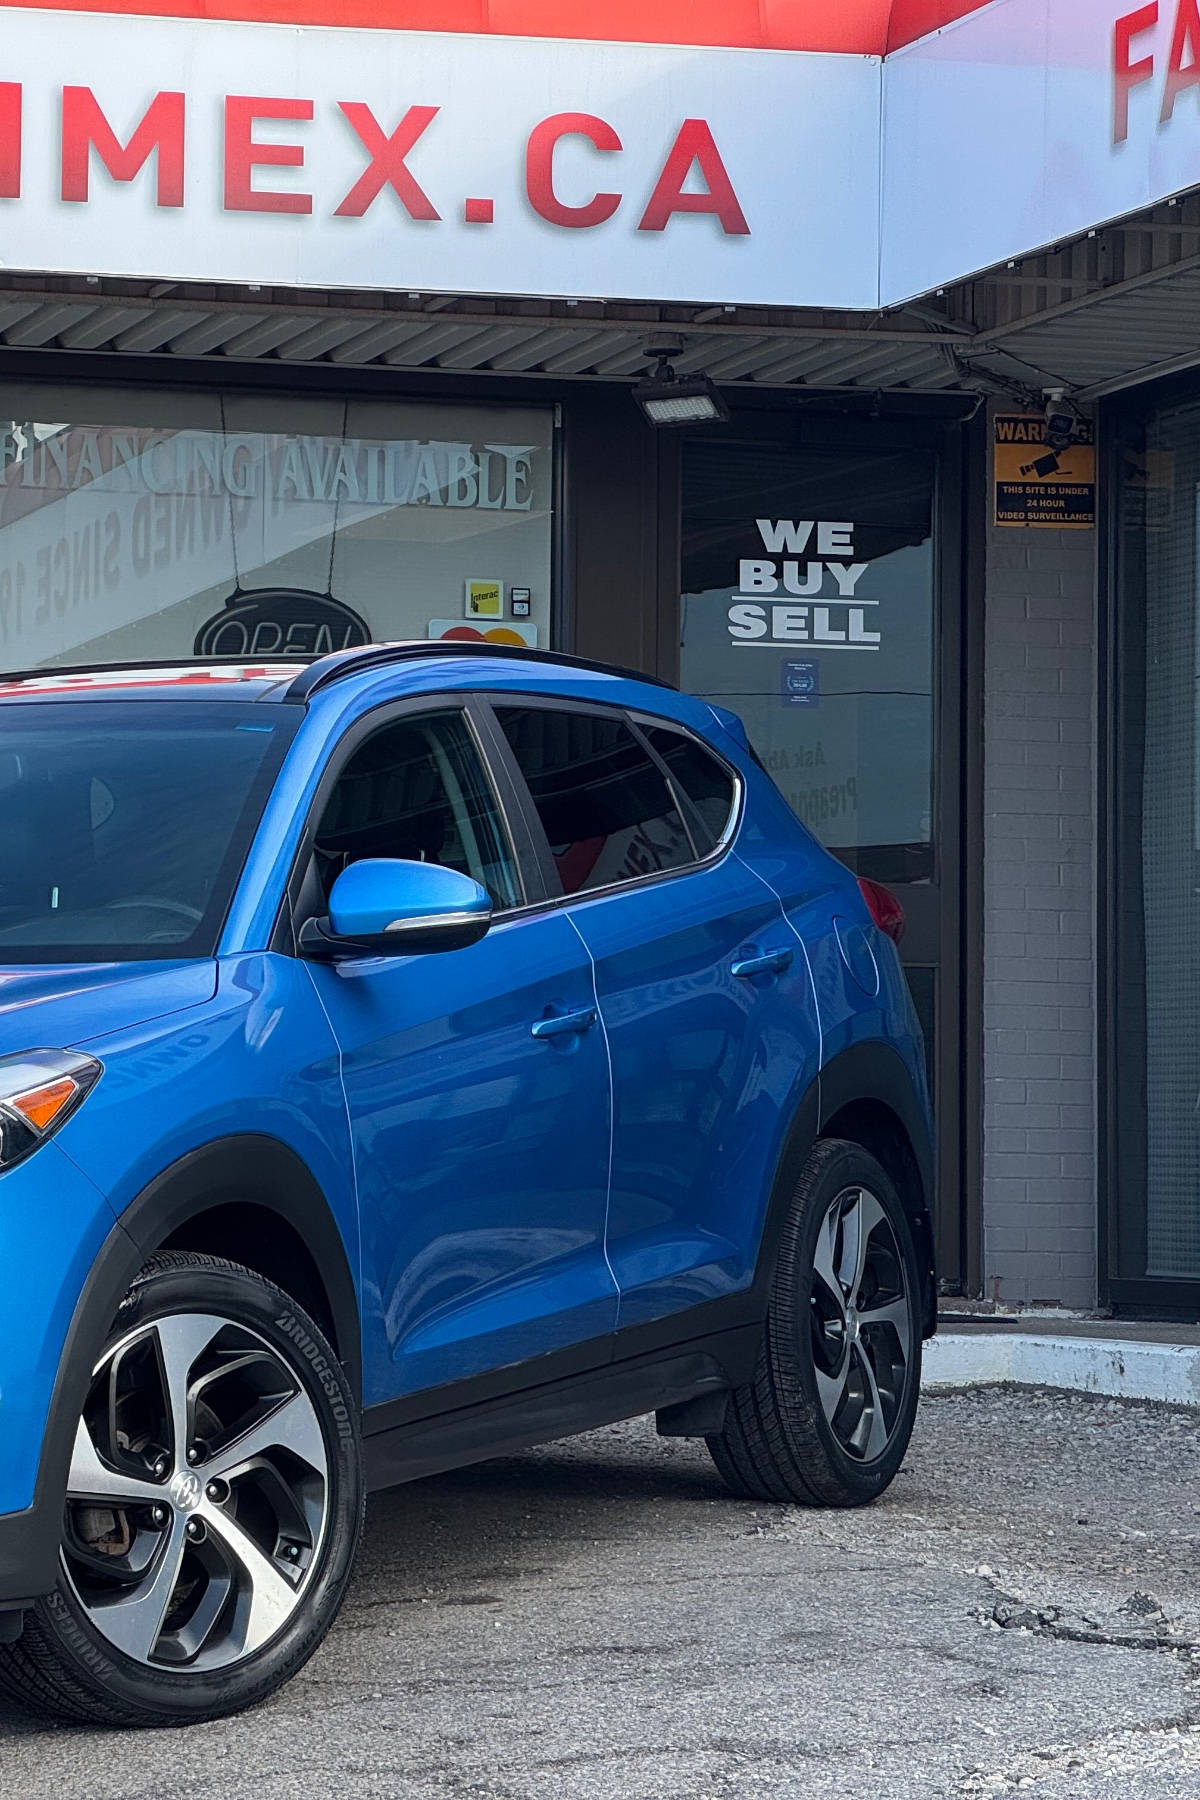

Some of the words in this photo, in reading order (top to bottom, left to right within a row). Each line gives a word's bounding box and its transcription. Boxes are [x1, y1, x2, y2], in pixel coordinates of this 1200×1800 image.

[997, 422, 1093, 442] WARG!
[277, 440, 533, 511] AVAILABLE
[1002, 485, 1023, 495] THIS
[1025, 486, 1045, 495] SITE
[1047, 486, 1057, 495] IS
[1058, 486, 1089, 495] UNDER
[997, 511, 1026, 520] VIDEO
[1027, 512, 1094, 521] SURVEILLANCE
[1026, 499, 1038, 507] 24
[1040, 499, 1066, 508] HOUR
[755, 518, 855, 556] WE
[739, 558, 870, 597] BUY
[470, 591, 499, 602] Interac
[211, 620, 353, 656] OPEN
[727, 604, 882, 642] SELL
[274, 1309, 355, 1451] BRIDGESTONE
[46, 1591, 118, 1680] BRIDGES
